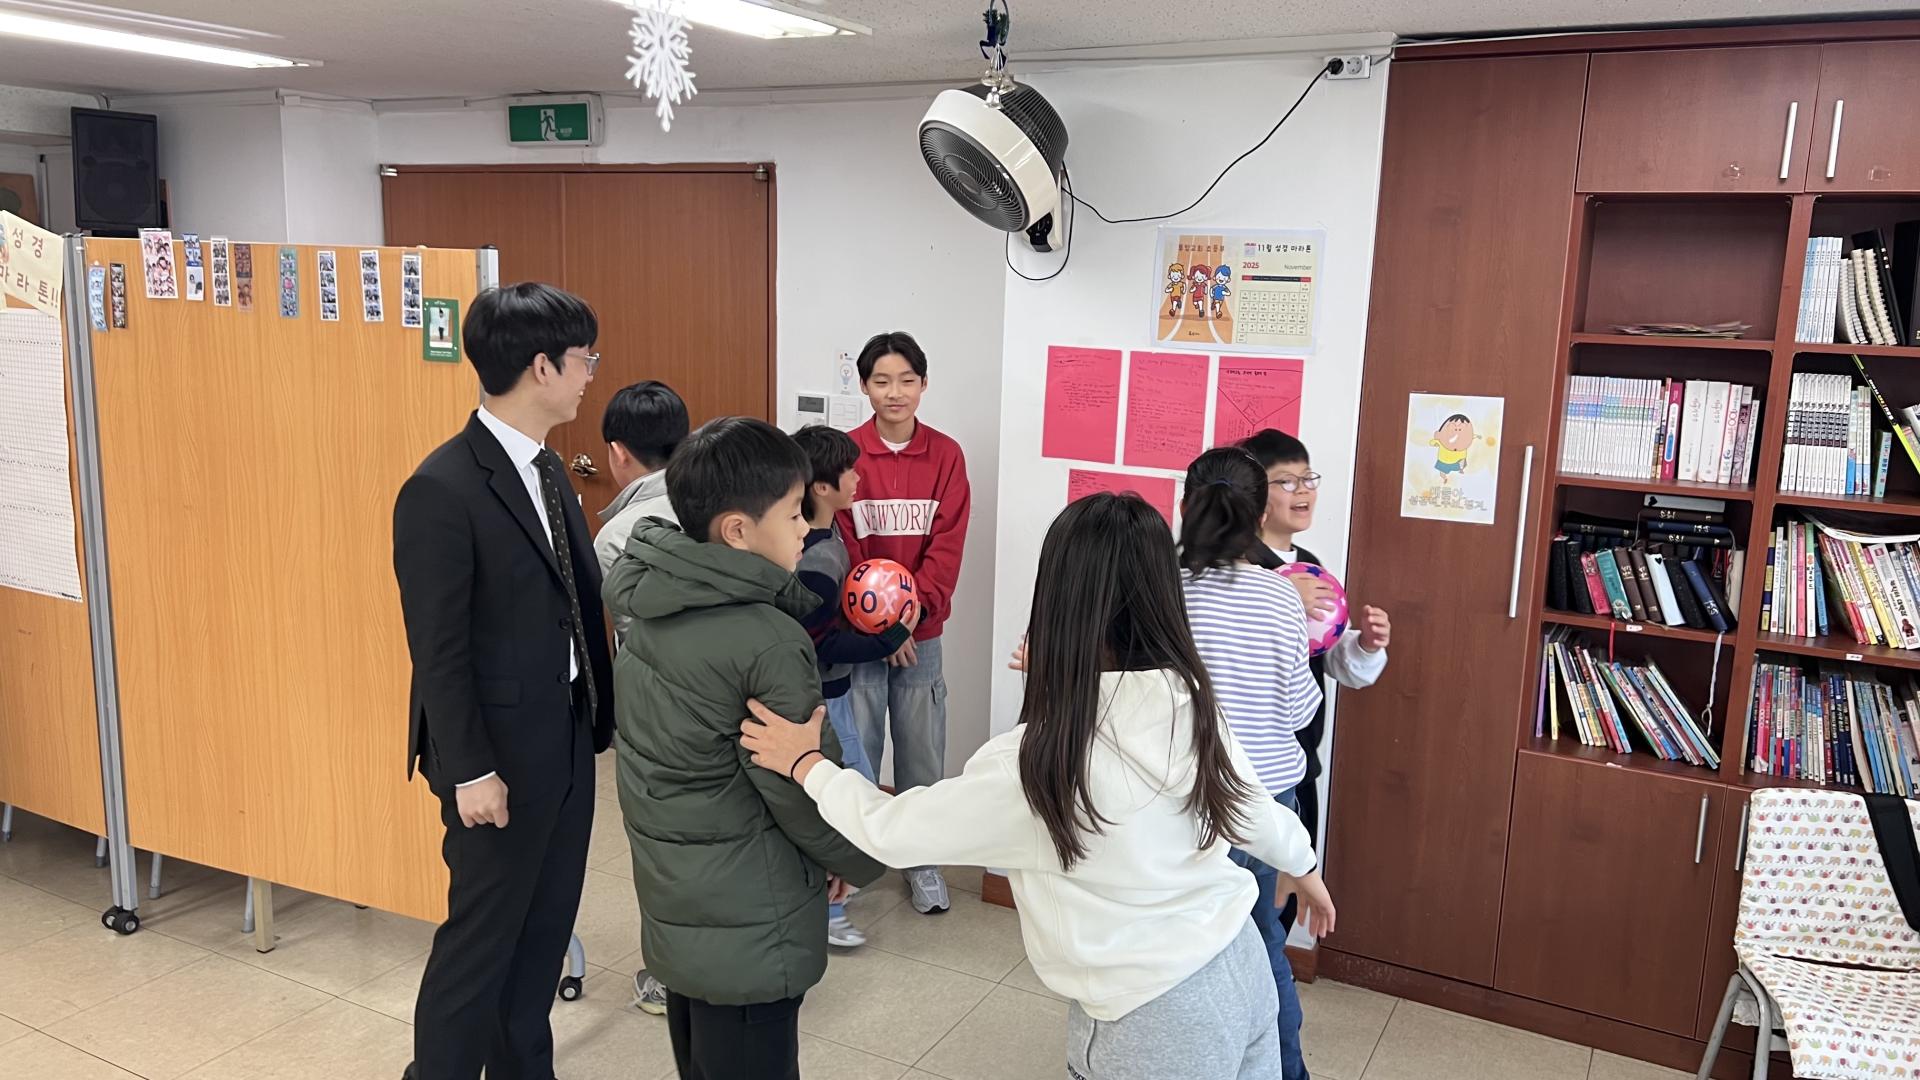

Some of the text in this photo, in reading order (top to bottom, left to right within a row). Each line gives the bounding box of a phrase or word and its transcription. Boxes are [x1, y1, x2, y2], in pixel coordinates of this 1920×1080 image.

[12, 227, 44, 258] 성경
[1257, 244, 1272, 253] 11월
[1275, 244, 1288, 253] 성경
[1291, 245, 1312, 254] 마라톤
[1242, 261, 1260, 269] 2025
[1284, 263, 1312, 271] November
